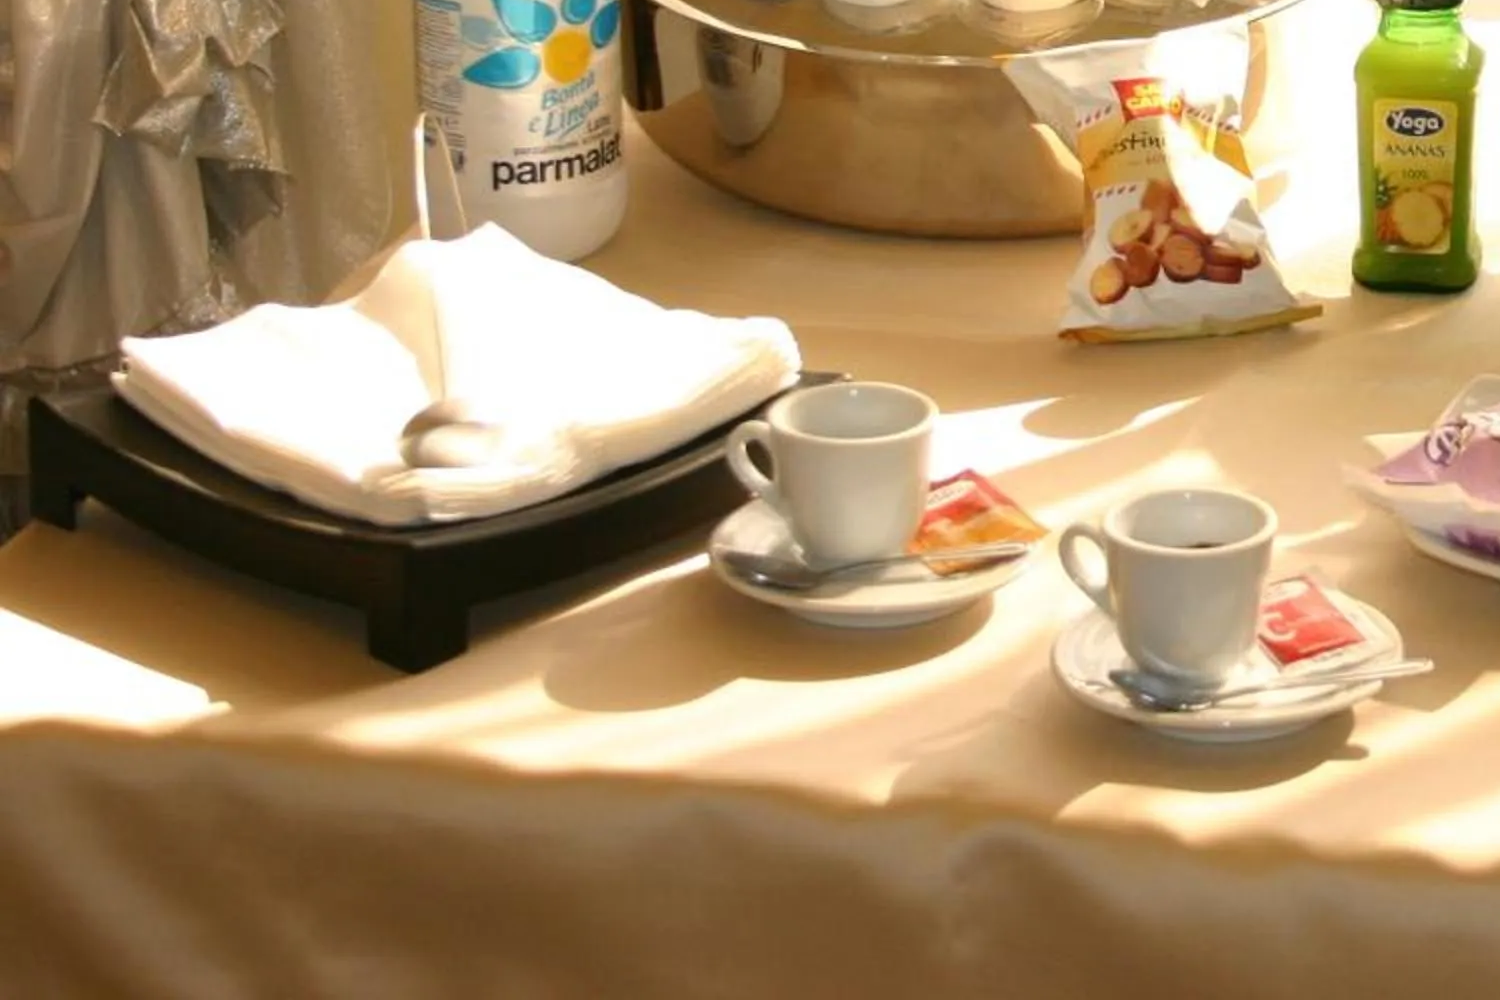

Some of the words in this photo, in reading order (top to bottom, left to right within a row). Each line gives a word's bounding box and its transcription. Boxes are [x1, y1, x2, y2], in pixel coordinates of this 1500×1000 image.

[1391, 110, 1440, 135] Yoga
[492, 131, 622, 192] parmalat
[1385, 143, 1446, 158] ANANAS
